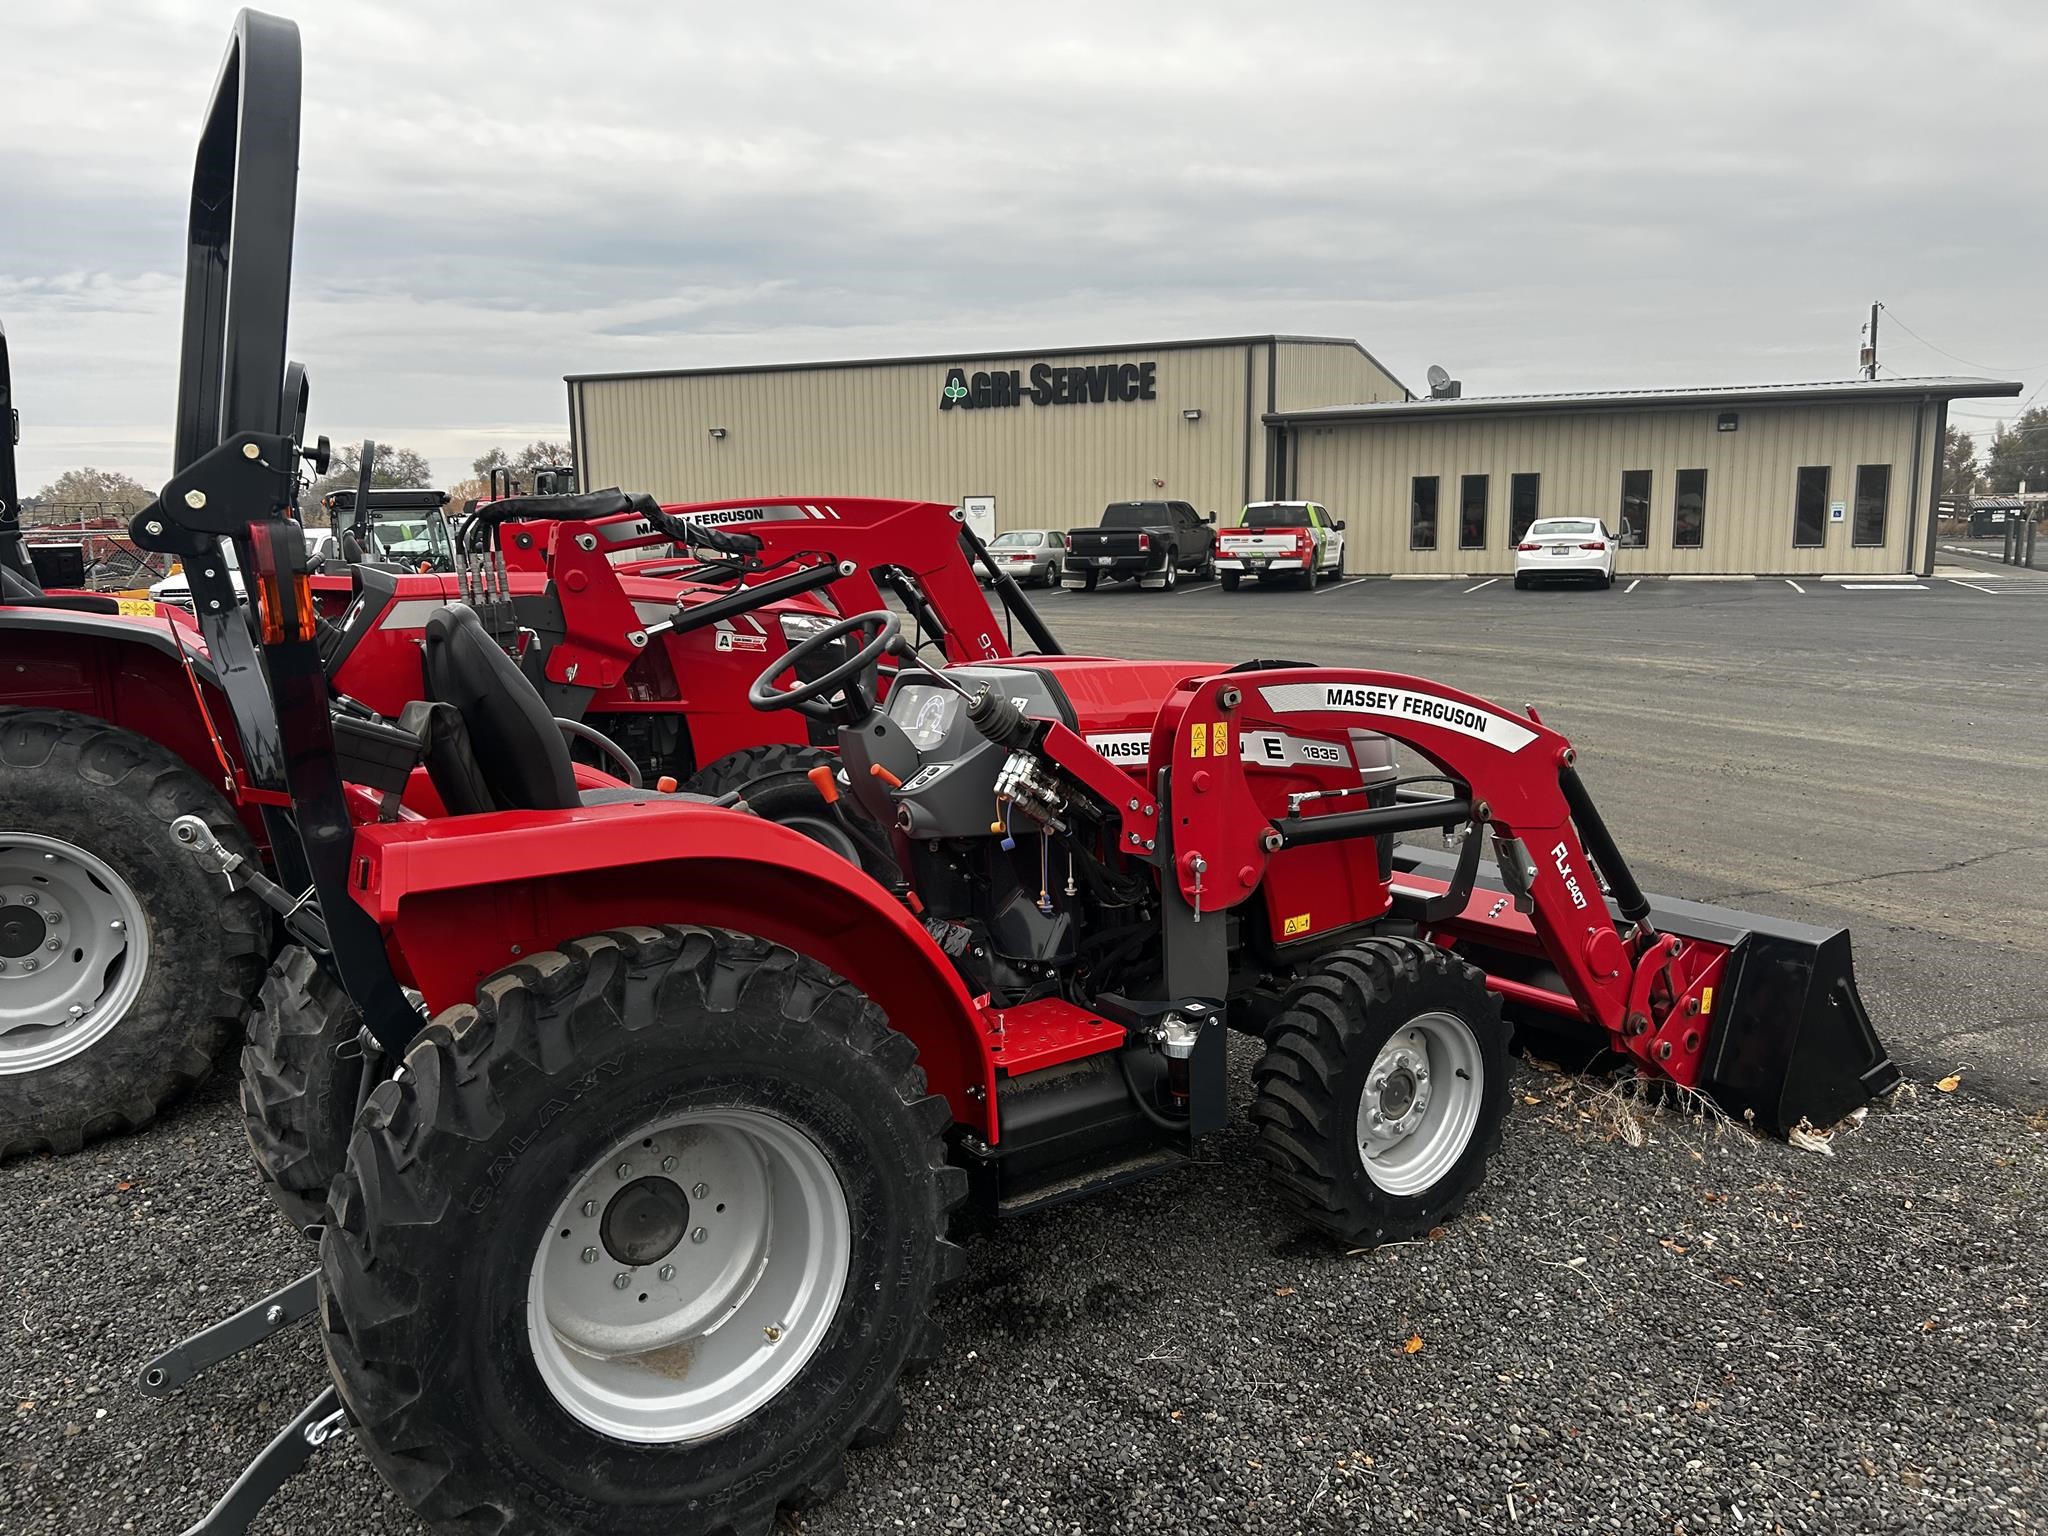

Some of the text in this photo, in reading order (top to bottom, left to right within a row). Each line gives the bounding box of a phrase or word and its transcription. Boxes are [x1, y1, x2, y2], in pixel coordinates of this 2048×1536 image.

[939, 361, 1156, 410] AGRI-SERVICE
[694, 509, 763, 525] FERGUSON
[1326, 689, 1487, 732] MASSEY FERGUSON
[1095, 742, 1150, 757] MASSE
[1262, 738, 1284, 760] E
[1303, 746, 1339, 761] 1835
[1565, 876, 1587, 910] 2407
[468, 1052, 627, 1215] GALAXY
